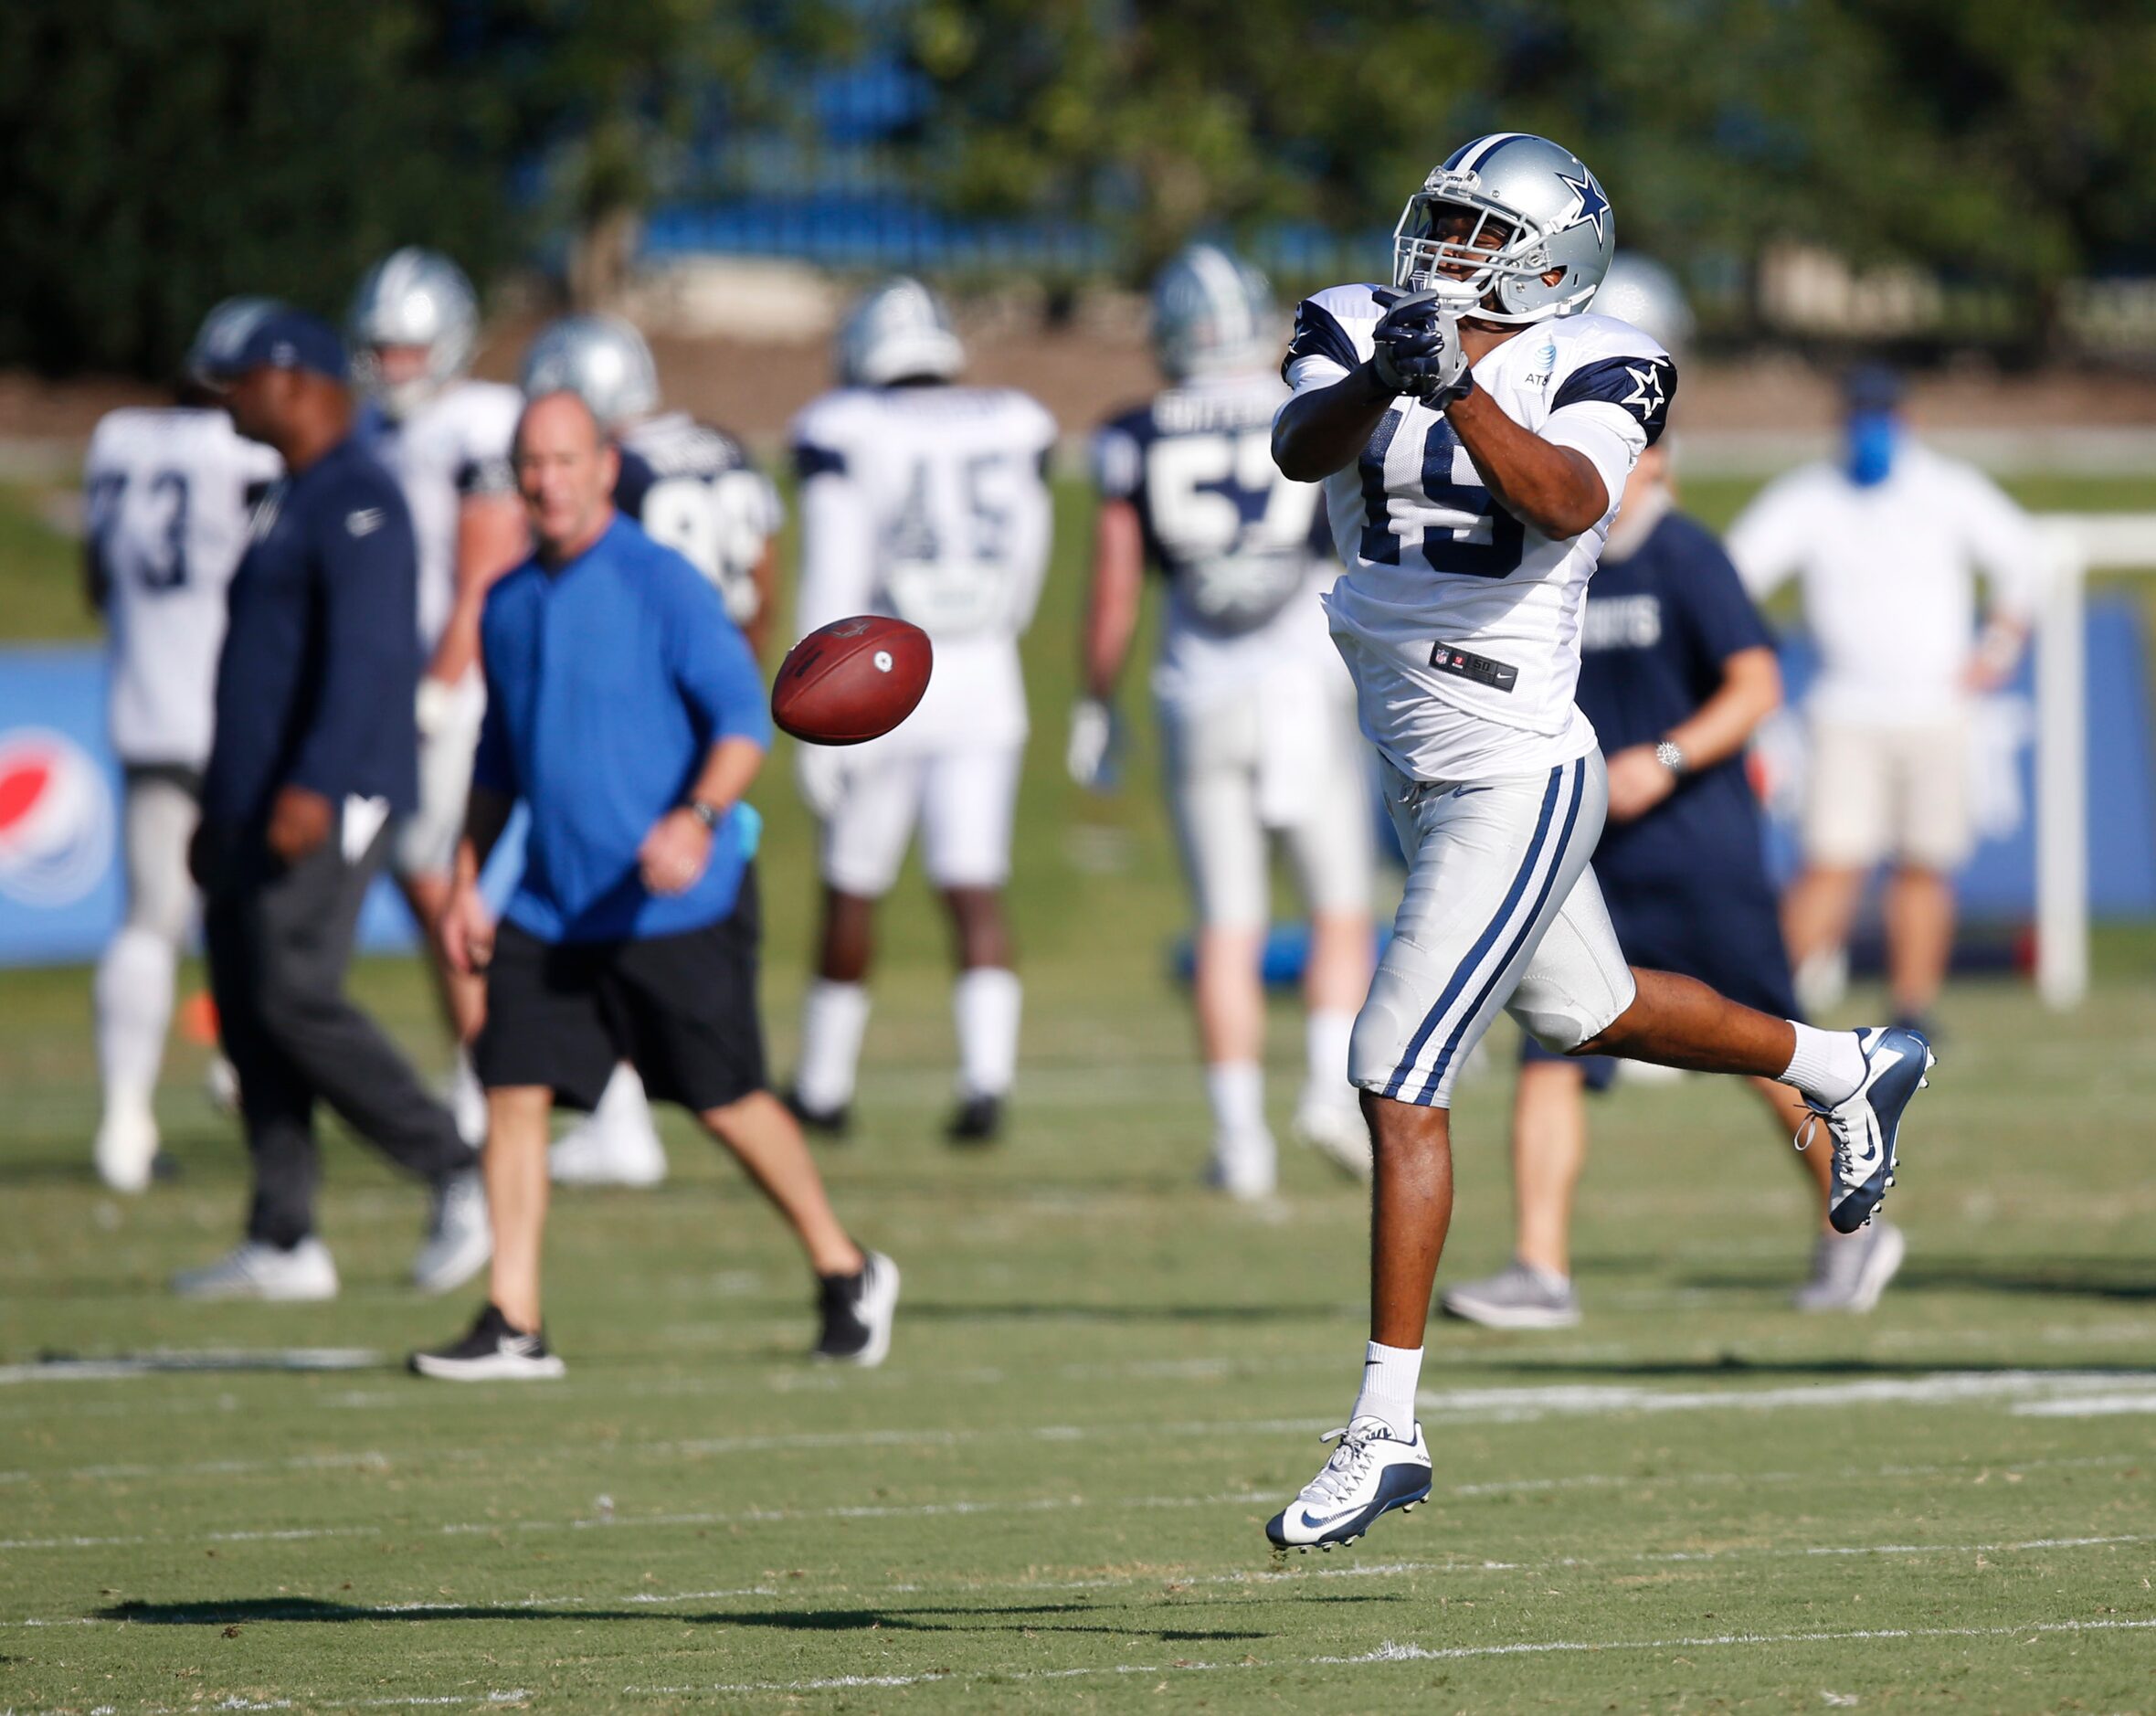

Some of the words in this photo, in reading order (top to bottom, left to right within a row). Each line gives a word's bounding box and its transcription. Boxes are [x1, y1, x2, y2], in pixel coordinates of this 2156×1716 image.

[1525, 373, 1553, 387] AT&
[89, 468, 190, 590] 73
[877, 455, 1013, 561] 45
